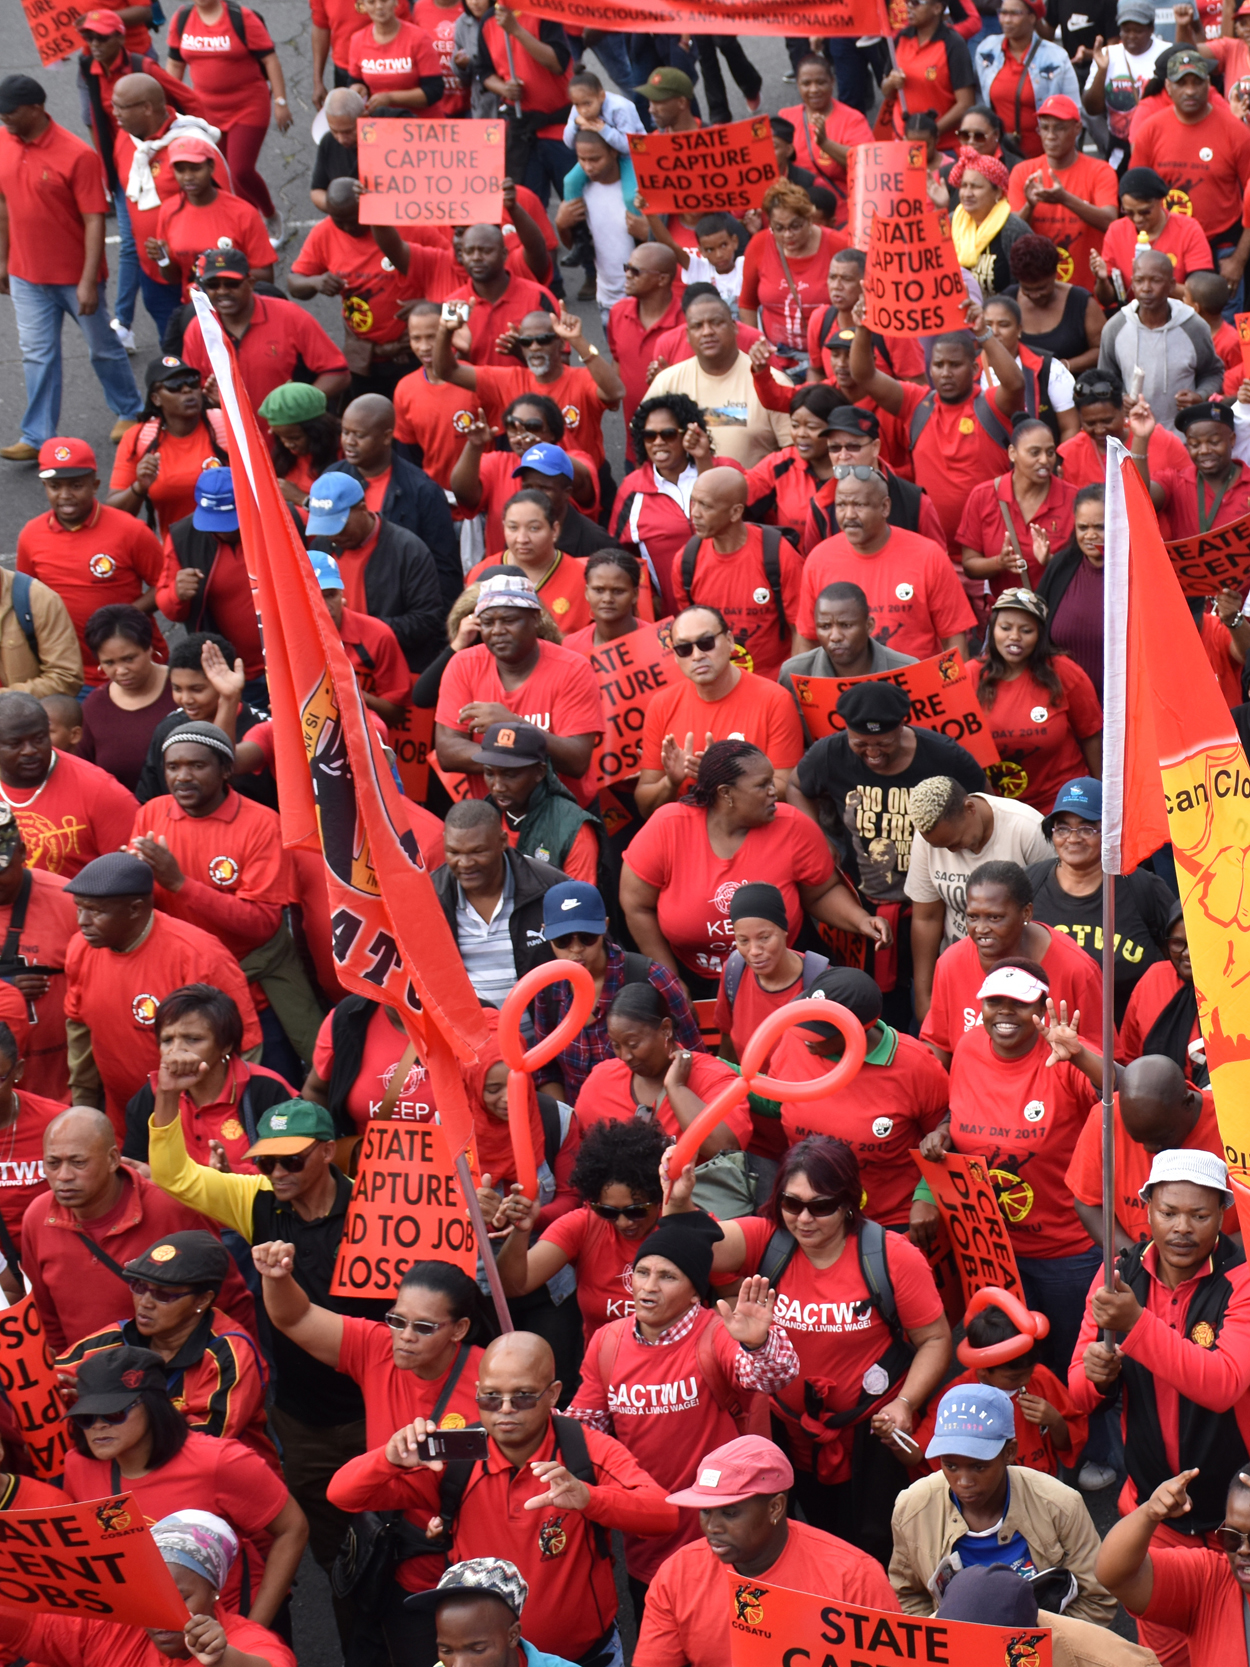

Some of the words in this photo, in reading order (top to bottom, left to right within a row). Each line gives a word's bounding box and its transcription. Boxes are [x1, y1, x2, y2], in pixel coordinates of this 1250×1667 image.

[568, 4, 683, 22] CONSCIOUSNESS
[688, 10, 717, 23] AND
[722, 12, 854, 28] INTERNATIONALISM
[182, 33, 231, 48] SACTWU
[361, 57, 412, 72] SACTWU
[403, 124, 460, 142] STATE
[671, 128, 729, 150] STATE
[384, 150, 478, 168] CAPTURE
[657, 147, 752, 170] CAPTURE
[364, 176, 417, 194] LEAD
[424, 176, 452, 194] TO
[461, 176, 500, 194] JOB
[640, 174, 692, 190] LEAD
[698, 168, 728, 188] TO
[736, 164, 776, 185] JOB
[396, 201, 470, 220] LOSSES
[673, 190, 751, 209] LOSSES
[876, 220, 926, 244] STATE
[870, 246, 944, 273] APTURE
[892, 280, 924, 302] TO
[932, 272, 964, 300] JOB
[874, 306, 944, 330] LOSSES
[723, 400, 748, 410] Jeep
[888, 604, 913, 612] 2017
[590, 642, 634, 675] ATE
[600, 662, 668, 706] TURE
[608, 707, 644, 738] TO
[856, 785, 882, 812] NO
[888, 787, 913, 814] ON
[856, 808, 876, 838] IS
[882, 813, 914, 840] FRE
[934, 870, 971, 884] SACTW
[706, 918, 735, 937] KE
[959, 1122, 986, 1135] MAY
[990, 1126, 1012, 1138] DAY
[1016, 1128, 1046, 1139] 2017
[364, 1128, 434, 1162] STATE
[858, 1142, 891, 1152] 2017
[353, 1170, 457, 1208] APTURE
[378, 1214, 421, 1248] TO
[431, 1218, 474, 1252] JOB
[338, 1255, 424, 1290] LOSS
[773, 1293, 872, 1322] SACTWU
[815, 1323, 843, 1333] LIVING
[844, 1318, 872, 1331] WAGE!
[608, 1376, 698, 1408] SACTWU
[646, 1404, 669, 1414] LIVING
[671, 1397, 700, 1412] WAGE!
[938, 1402, 994, 1426] FABIANI
[100, 1526, 145, 1541] COSATU
[0, 1576, 114, 1614] OBS
[732, 1620, 772, 1638] COSATU
[820, 1606, 949, 1664] STATE
